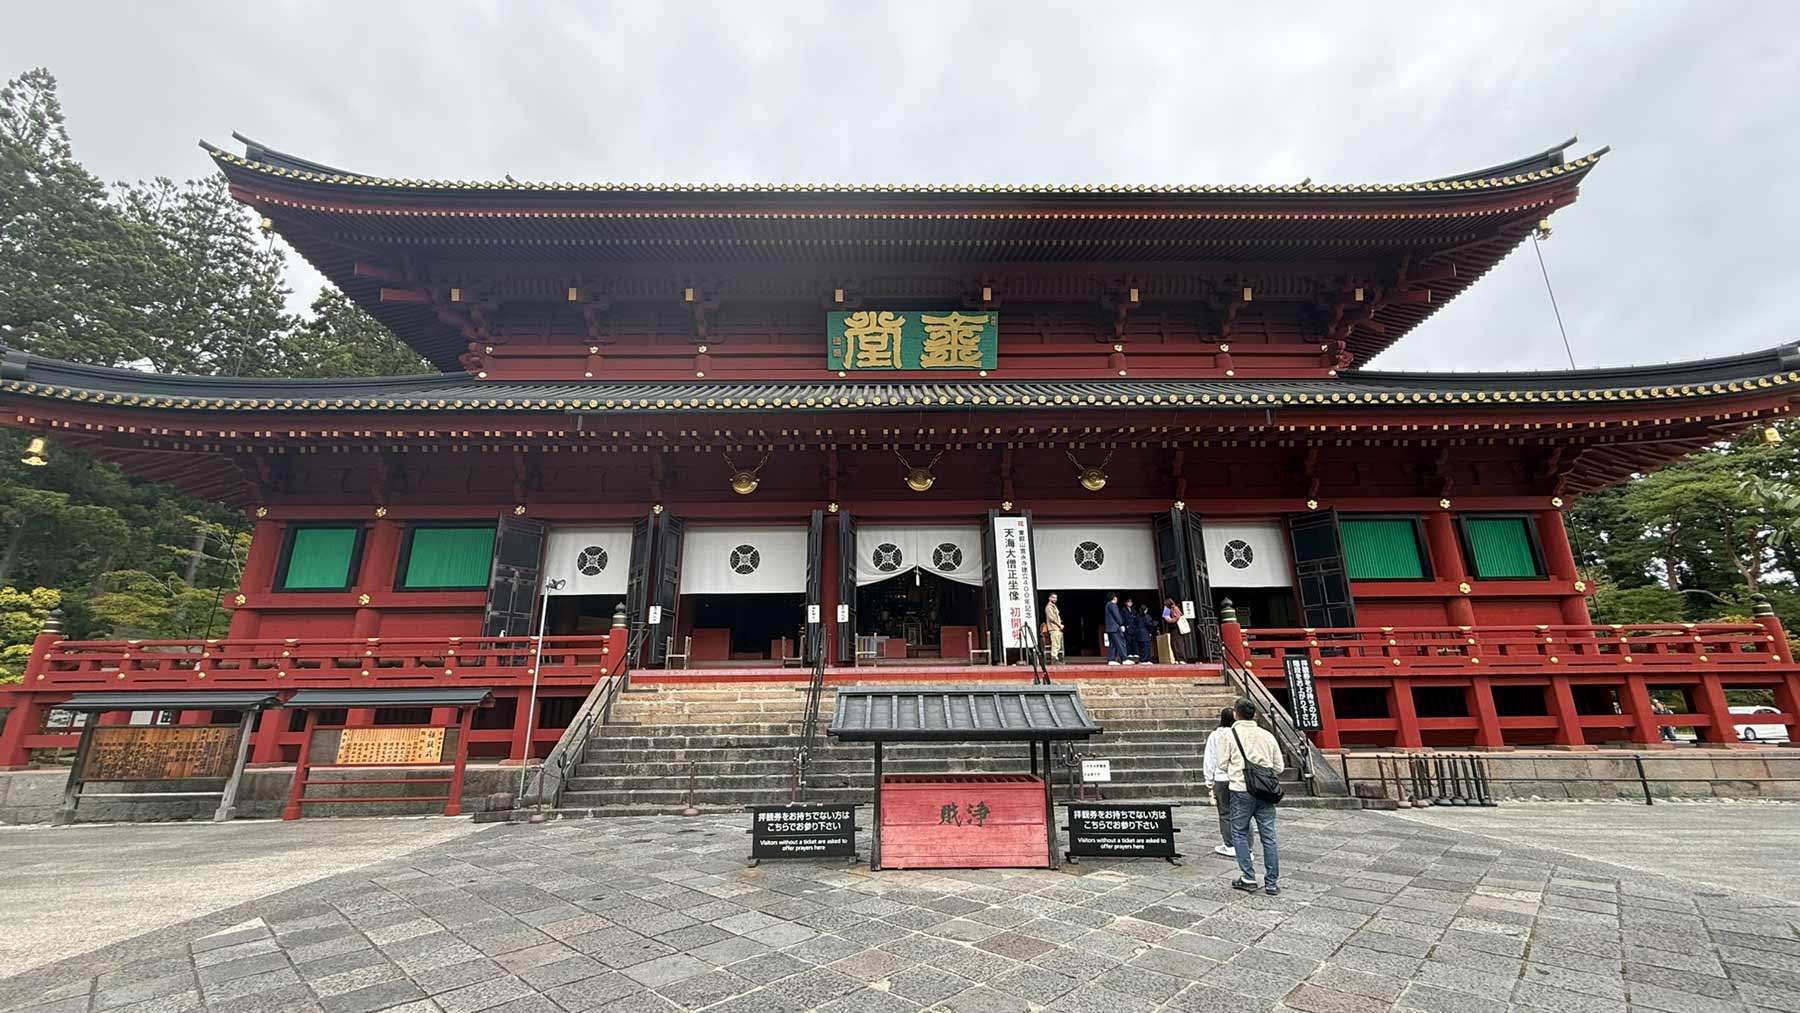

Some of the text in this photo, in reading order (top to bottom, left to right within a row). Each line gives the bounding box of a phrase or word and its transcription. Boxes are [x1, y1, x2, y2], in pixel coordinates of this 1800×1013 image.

[758, 811, 850, 822] 拝観券をお持ちでない方は
[1073, 810, 1167, 819] 拝観券をお持ちでない方は
[767, 822, 841, 832] こちらでお参り下さい
[1083, 820, 1159, 830] こちらでお参り下さい
